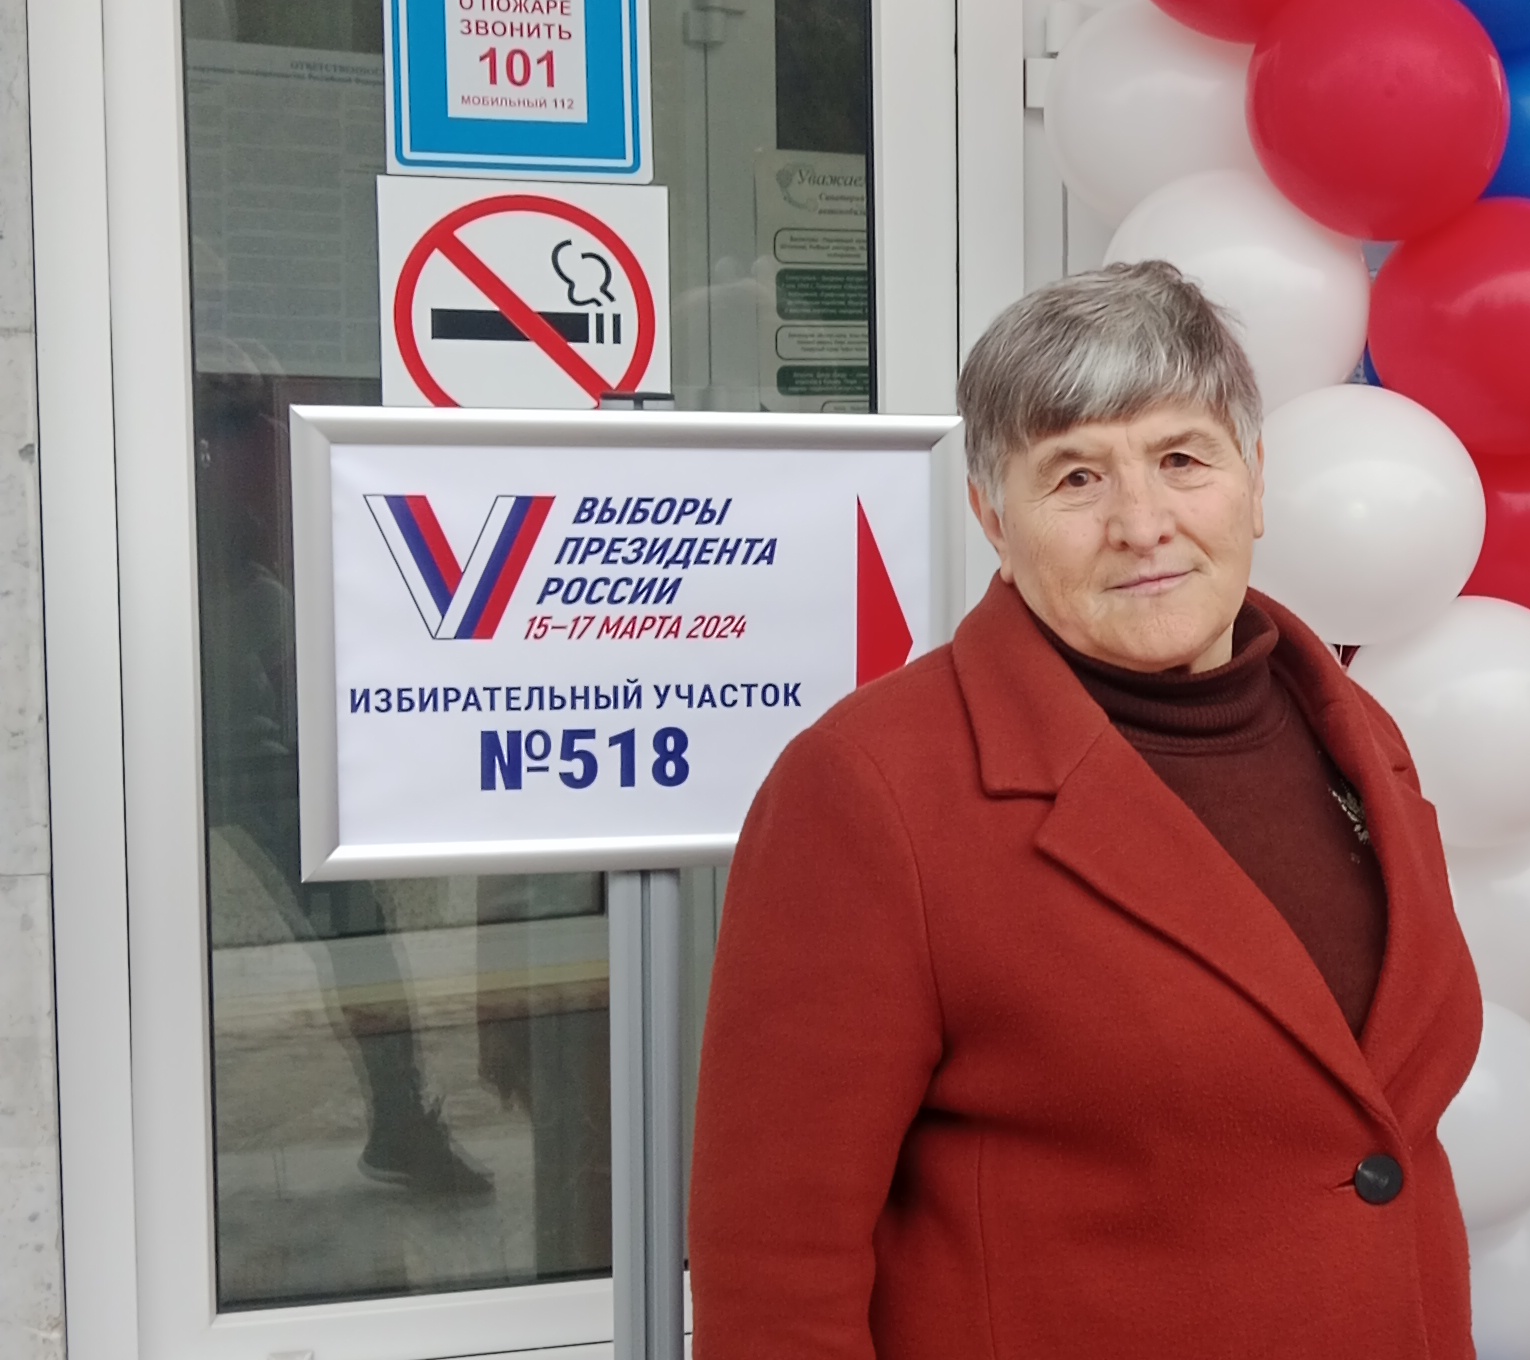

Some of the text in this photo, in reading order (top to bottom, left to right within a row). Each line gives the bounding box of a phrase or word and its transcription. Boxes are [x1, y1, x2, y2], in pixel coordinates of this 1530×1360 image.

[459, 19, 573, 41] ЗВОНИТЬ
[478, 47, 556, 89] 101
[460, 94, 575, 111] МОБИЛЬНЫЙ 112
[797, 168, 866, 188] Уважае
[572, 497, 732, 525] ВЫБОРЫ
[553, 537, 778, 569] ПРЕЗИДЕНТА
[536, 576, 683, 606] РОССИИ
[597, 615, 682, 640] МАРТА
[685, 614, 747, 639] 2024
[349, 677, 802, 715] ИЗБИРАТЕЛЬНЫЙ УЧАСТОК
[479, 726, 690, 792] №518
